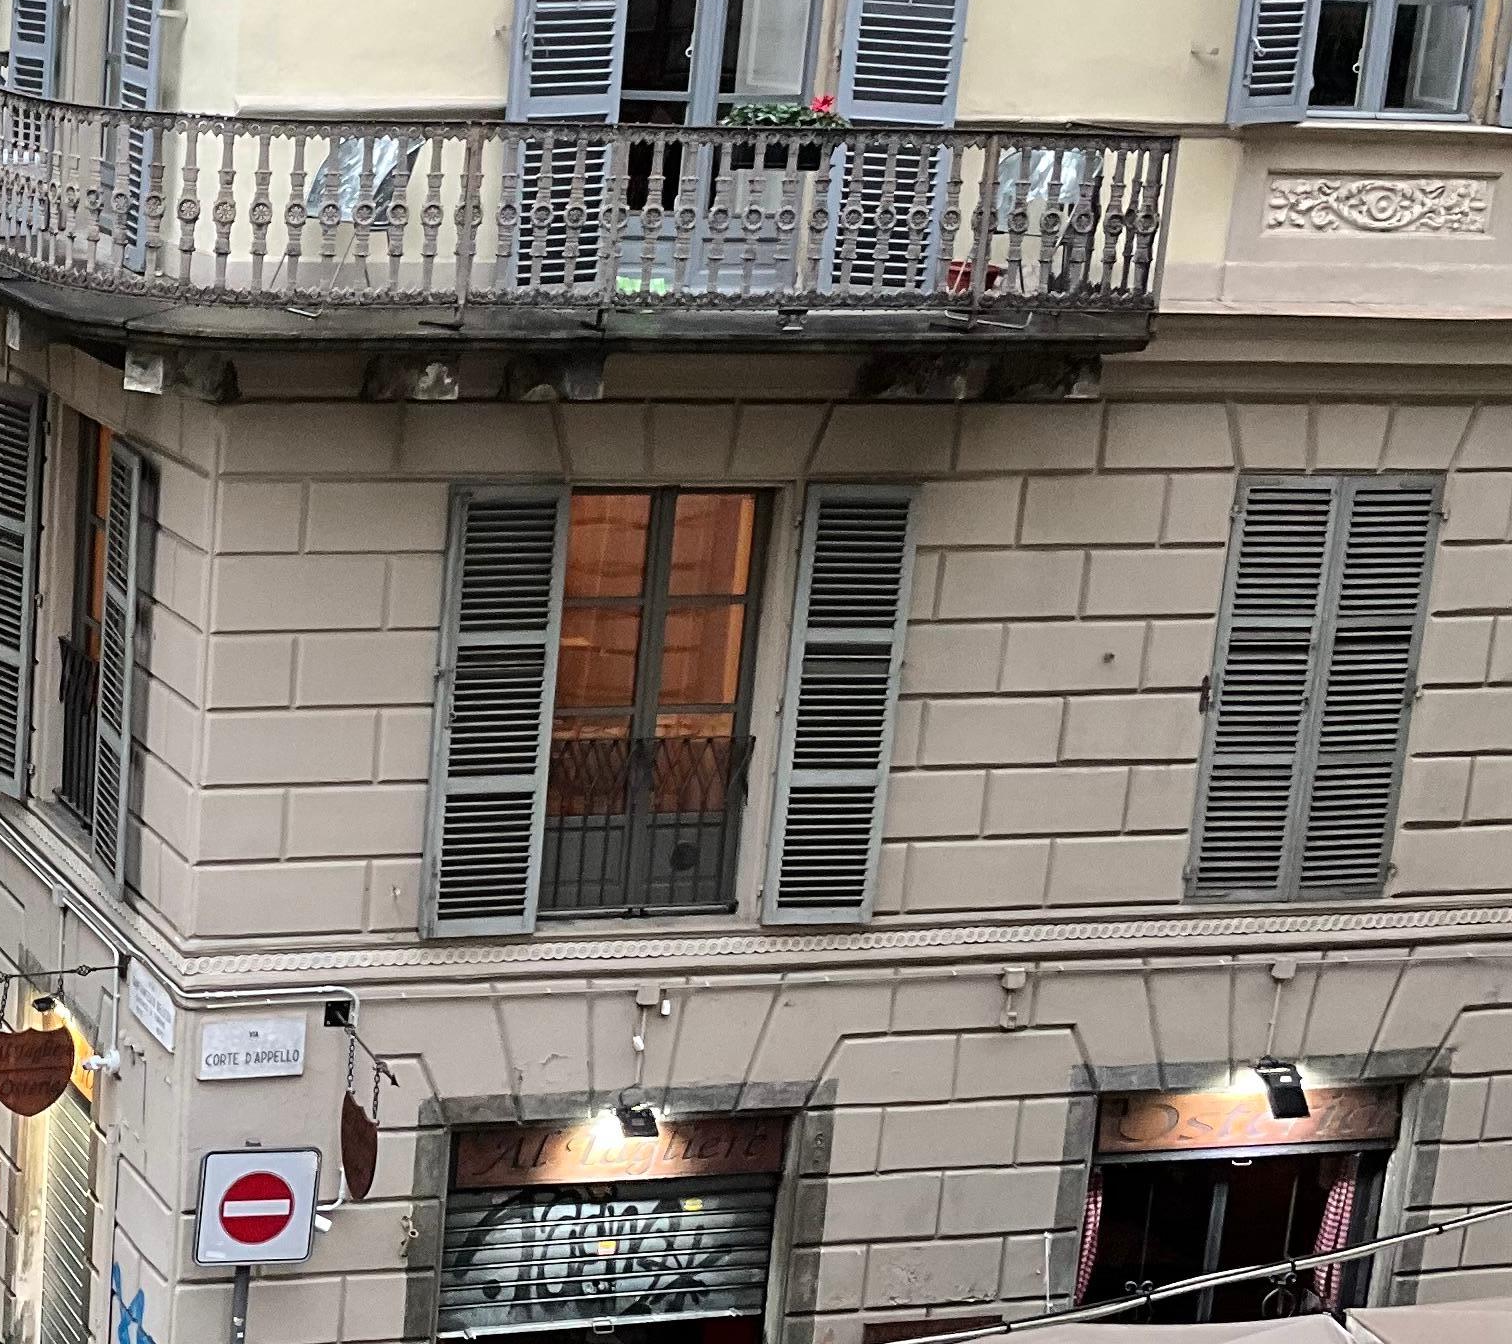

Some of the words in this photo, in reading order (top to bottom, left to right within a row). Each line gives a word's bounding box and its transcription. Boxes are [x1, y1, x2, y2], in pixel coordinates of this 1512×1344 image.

[248, 1029, 260, 1039] VIA
[205, 1051, 239, 1067] CORTE
[245, 1049, 301, 1065] D'APPELLO
